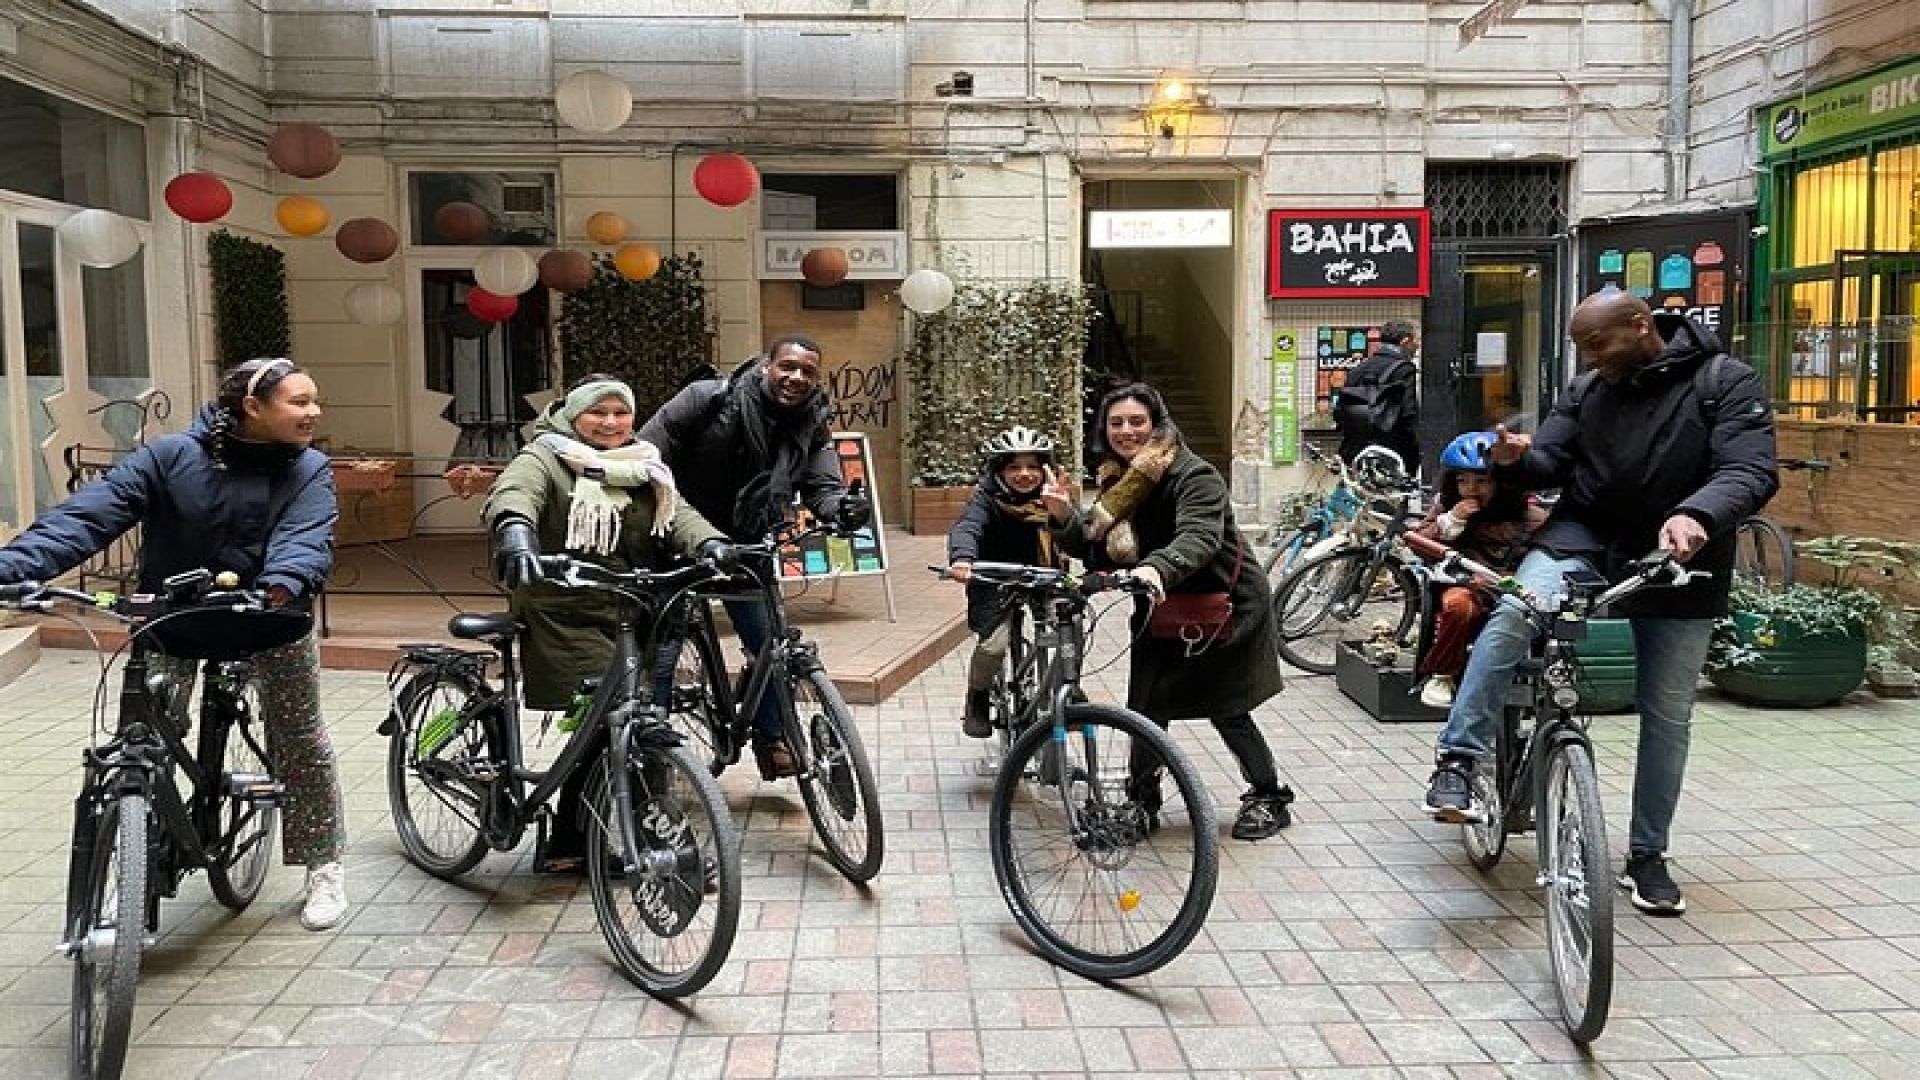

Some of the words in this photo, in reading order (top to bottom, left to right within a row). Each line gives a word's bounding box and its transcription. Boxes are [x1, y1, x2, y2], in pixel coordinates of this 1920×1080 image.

[1290, 222, 1414, 254] BAHIA
[775, 246, 888, 263] RAOM
[1651, 306, 1721, 325] GE
[1319, 357, 1368, 369] LUGG
[827, 358, 897, 401] NDOM
[1275, 362, 1294, 410] RENT
[827, 399, 892, 430] ARAT
